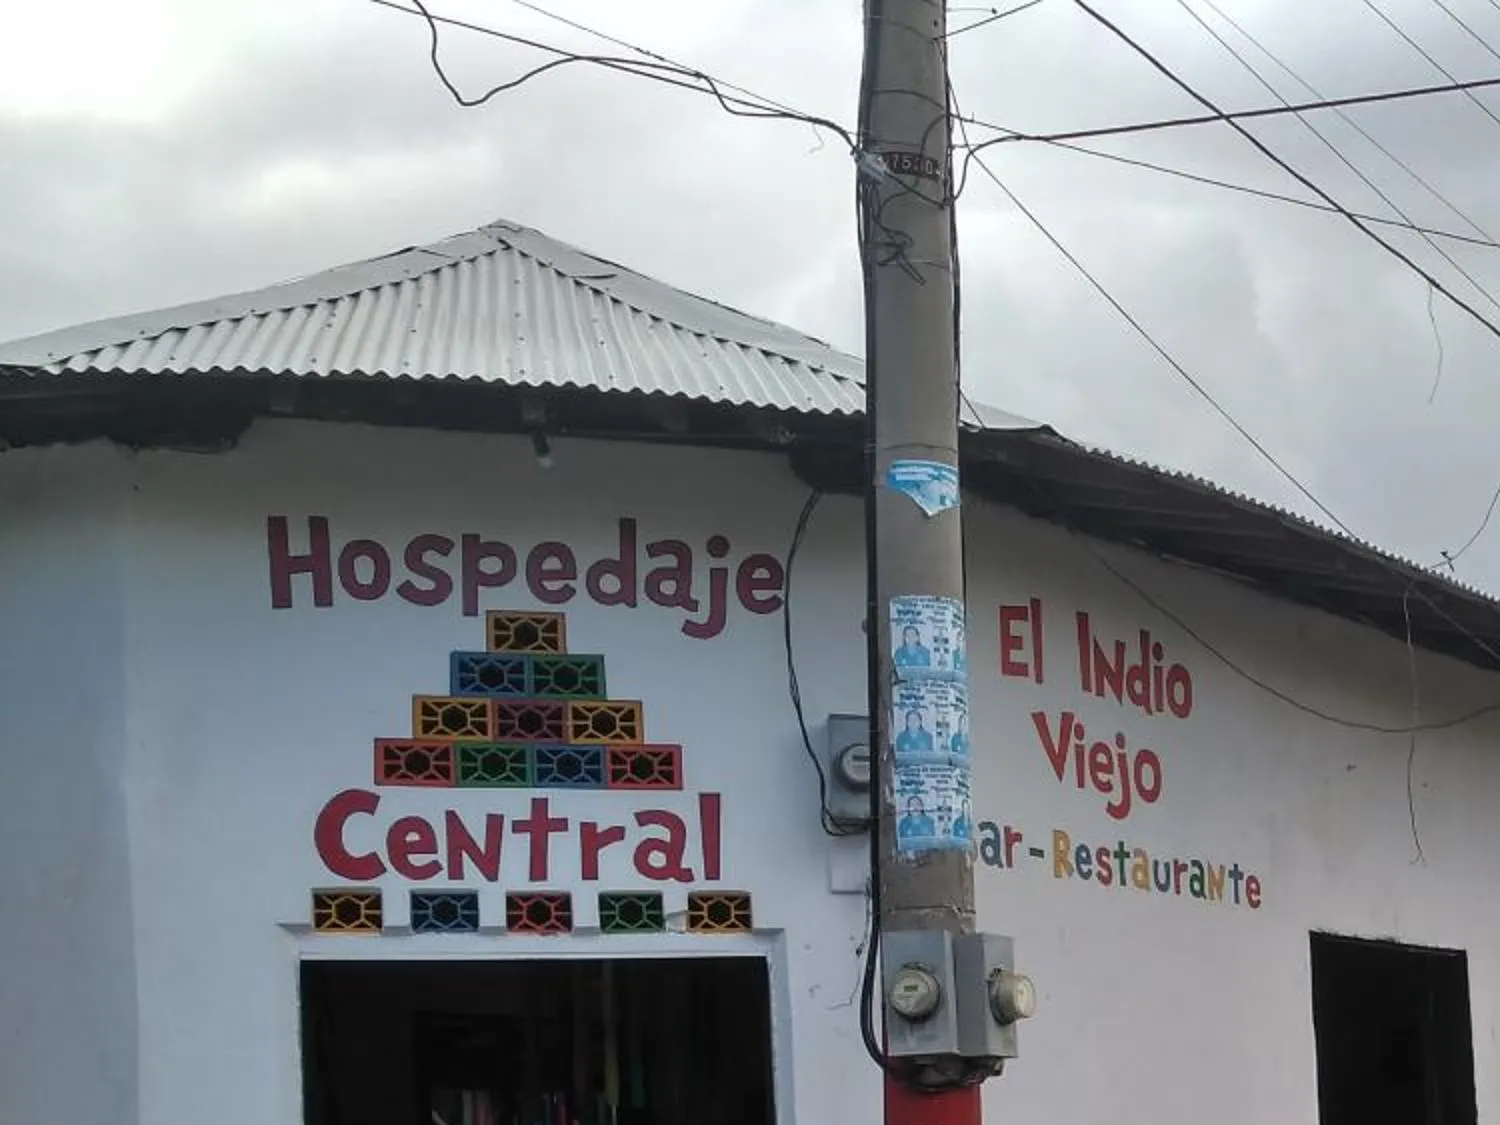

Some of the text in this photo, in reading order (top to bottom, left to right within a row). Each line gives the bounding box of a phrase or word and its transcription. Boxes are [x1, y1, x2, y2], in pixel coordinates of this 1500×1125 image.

[267, 515, 785, 640] Hospedaje
[999, 596, 1044, 685] El
[1031, 711, 1163, 820] Viejo
